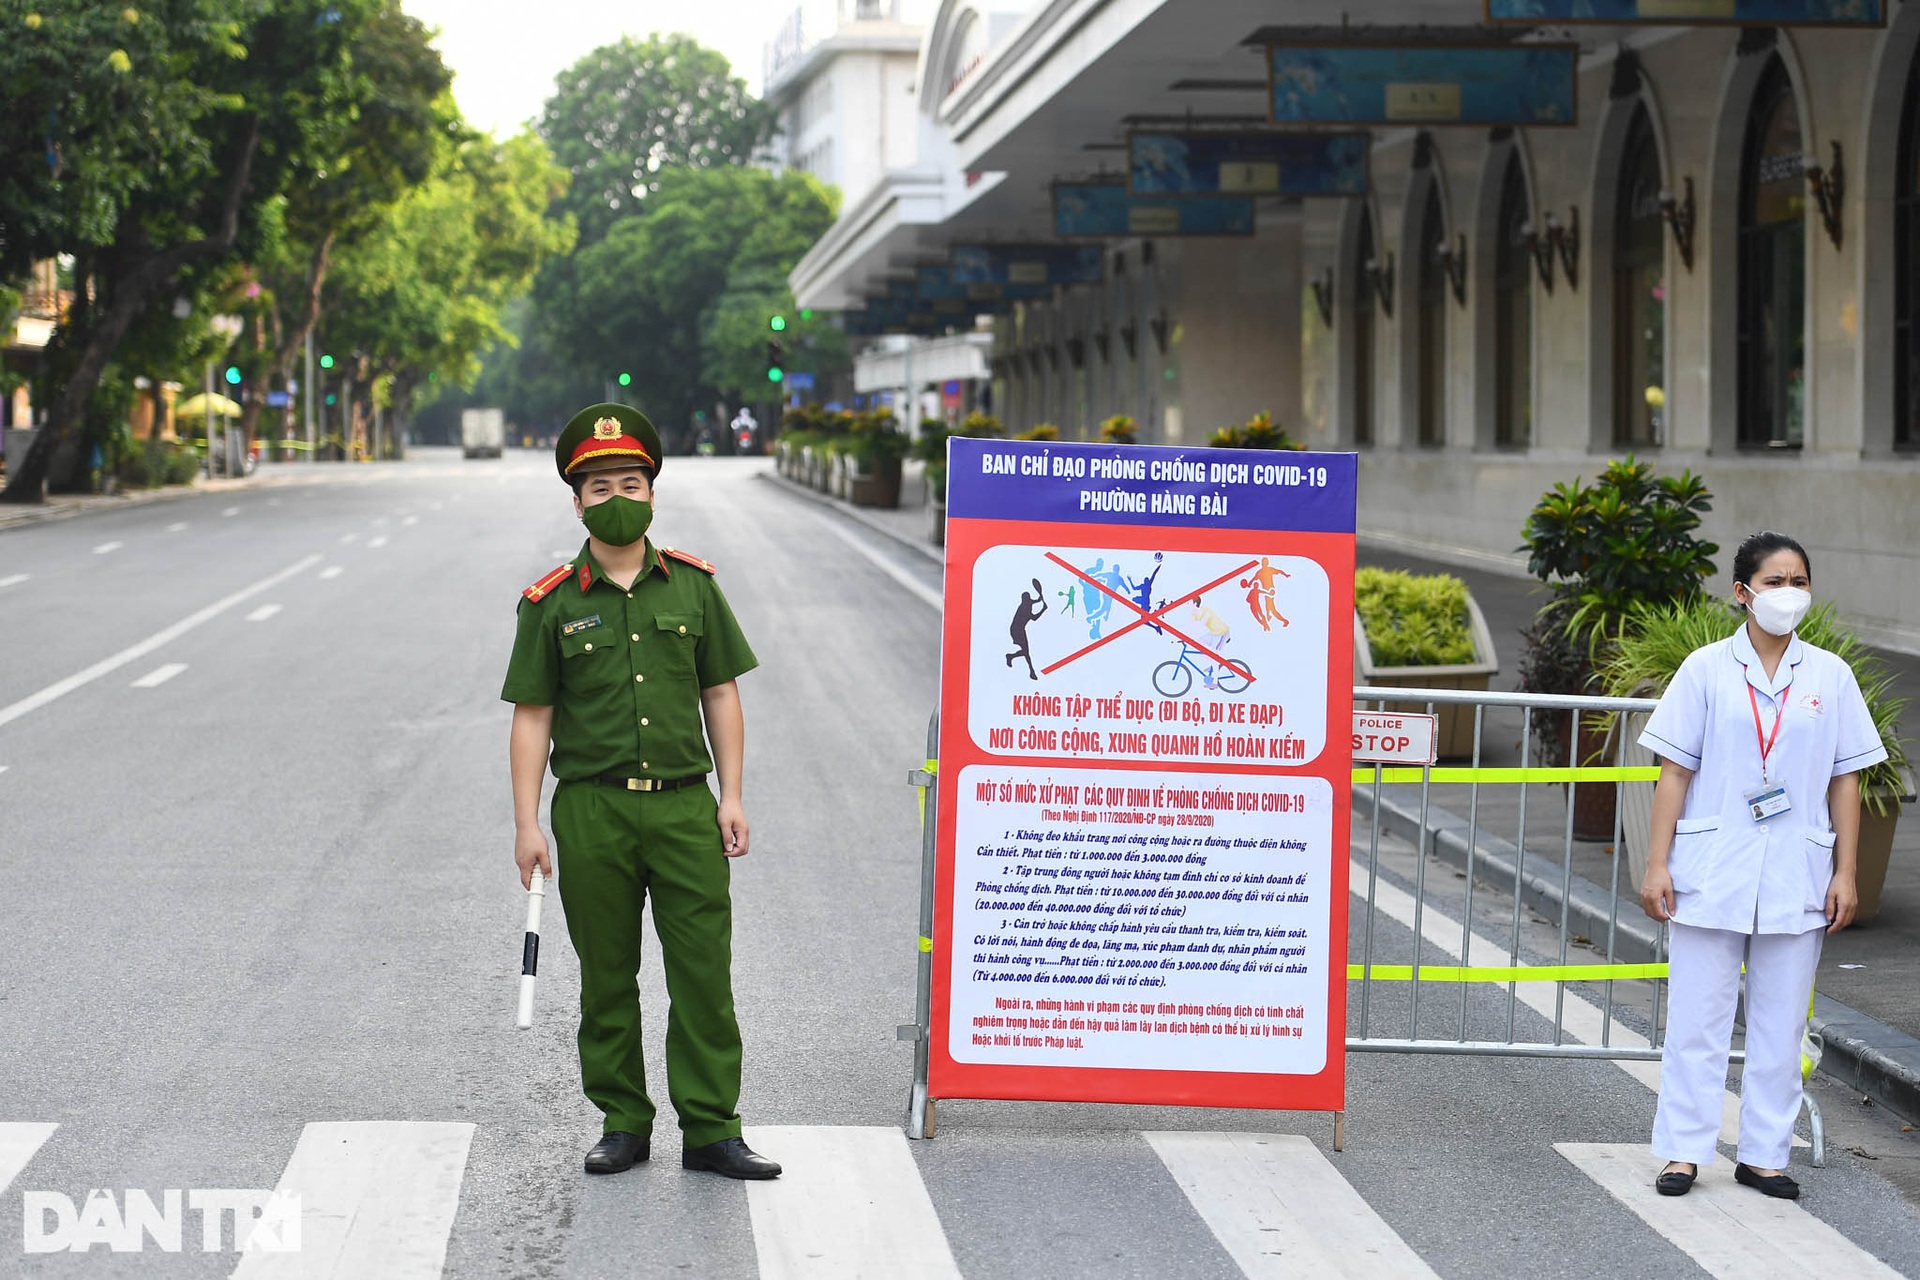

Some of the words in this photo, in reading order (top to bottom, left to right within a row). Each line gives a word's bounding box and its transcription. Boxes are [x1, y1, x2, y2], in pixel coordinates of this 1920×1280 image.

[982, 454, 1016, 475] BAN
[1021, 449, 1049, 476] CHỈ
[1052, 457, 1086, 482] ĐẠO
[1090, 454, 1146, 480] PHÒNG
[1151, 454, 1206, 483] CHỐNG
[1210, 463, 1248, 488] DỊCH
[1253, 465, 1327, 487] COVID-19
[1080, 487, 1146, 513] PHƯỜNG
[1151, 490, 1196, 515] HÀNG
[1200, 492, 1228, 516] BÀI
[1013, 692, 1061, 717] KHÔNG
[1066, 693, 1092, 722] TẬP
[1096, 691, 1123, 719] THỂ
[1126, 700, 1154, 725] DỤC
[1159, 701, 1178, 723] (ĐI
[1182, 698, 1205, 727] BỘ,
[1209, 702, 1223, 723] ĐI
[1228, 703, 1246, 724] XE
[1250, 704, 1283, 729] ĐẠP)
[1360, 719, 1402, 729] POLICE
[990, 727, 1014, 749] NƠI
[1018, 725, 1057, 751] CÔNG
[1061, 727, 1104, 756] CỘNG,
[1108, 733, 1147, 754] XUNG
[1152, 734, 1199, 757] QUANH
[1204, 730, 1222, 757] HỒ
[1227, 733, 1265, 758] HOÀN
[1270, 732, 1305, 760] KIẾM
[1352, 733, 1410, 752] STOP
[976, 779, 997, 806] MỘT
[999, 777, 1013, 803] SỐ
[1015, 779, 1036, 804] MỨC
[1039, 777, 1054, 805] XỬ
[1054, 785, 1079, 809] PHẠT
[1084, 783, 1104, 806] CÁC
[1106, 787, 1125, 808] QUY
[1127, 788, 1150, 811] ĐỊNH
[1153, 783, 1164, 808] VỀ
[1166, 786, 1199, 809] PHÒNG
[1202, 785, 1234, 811] CHỐNG
[1237, 792, 1259, 815] DỊCH
[1262, 793, 1304, 813] COVID-19
[1063, 810, 1079, 824] Nghị
[1081, 810, 1097, 825] Định
[1100, 812, 1156, 825] 117/2020/NĐ-CP
[1158, 814, 1175, 827] ngày
[1177, 814, 1214, 827] 28/9/2020)
[1004, 831, 1010, 839] 1
[1016, 830, 1044, 843] Không
[1046, 830, 1061, 841] đeo
[1087, 834, 1111, 846] trang
[1112, 834, 1127, 844] nơi
[1128, 834, 1148, 847] công
[1150, 834, 1170, 848] cộng
[1171, 836, 1192, 846] hoặc
[1204, 836, 1232, 850] đường
[1280, 839, 1307, 852] không
[977, 844, 994, 857] Cần
[996, 846, 1019, 857] thiết.
[1070, 849, 1081, 860] từ
[1081, 852, 1122, 861] 1.000.000
[1124, 850, 1140, 862] đến
[1142, 854, 1184, 863] 3.000.000
[1185, 852, 1208, 867] đồng
[975, 881, 1003, 895] Phòng
[1004, 881, 1030, 896] chống
[1100, 886, 1112, 896] từ
[1112, 888, 1156, 898] 10.000.000
[1158, 886, 1174, 898] đến
[1175, 890, 1220, 900] 30.000.000
[1222, 888, 1244, 903] đồng
[1245, 889, 1259, 901] đối
[1261, 892, 1275, 902] với
[1276, 892, 1286, 902] cá
[1287, 892, 1309, 903] nhân
[975, 898, 1026, 911] (20.000.000
[1027, 900, 1044, 912] đến
[1045, 903, 1092, 913] 40.000.000
[1093, 902, 1116, 917] đồng
[1117, 903, 1132, 915] đối
[1134, 905, 1148, 915] với
[1150, 903, 1161, 916] tổ
[1161, 905, 1186, 918] chức)
[1000, 920, 1007, 930] 3
[1032, 918, 1046, 930] trở
[1047, 920, 1068, 930] hoặc
[1069, 921, 1097, 934] không
[1120, 922, 1142, 933] hành
[1143, 923, 1160, 935] yêu
[1178, 924, 1204, 935] thanh
[1206, 926, 1221, 936] tra,
[1223, 924, 1245, 936] kiểm
[1247, 928, 1262, 938] tra,
[1264, 925, 1286, 938] kiểm
[1288, 928, 1307, 938] soát.
[974, 935, 986, 945] Có
[987, 935, 1000, 946] lời
[1001, 936, 1018, 947] nói,
[1020, 936, 1044, 947] hành
[1046, 937, 1068, 951] động
[1069, 938, 1080, 949] đe
[1102, 940, 1122, 953] lăng
[1142, 941, 1158, 951] xúc
[1159, 942, 1185, 954] phạm
[1187, 942, 1210, 953] danh
[1228, 944, 1251, 954] nhân
[1279, 945, 1306, 958] người
[972, 1034, 992, 1048] Hoặc
[1013, 1033, 1021, 1047] tố
[1023, 1036, 1043, 1047] trước
[1045, 1036, 1064, 1049] Pháp
